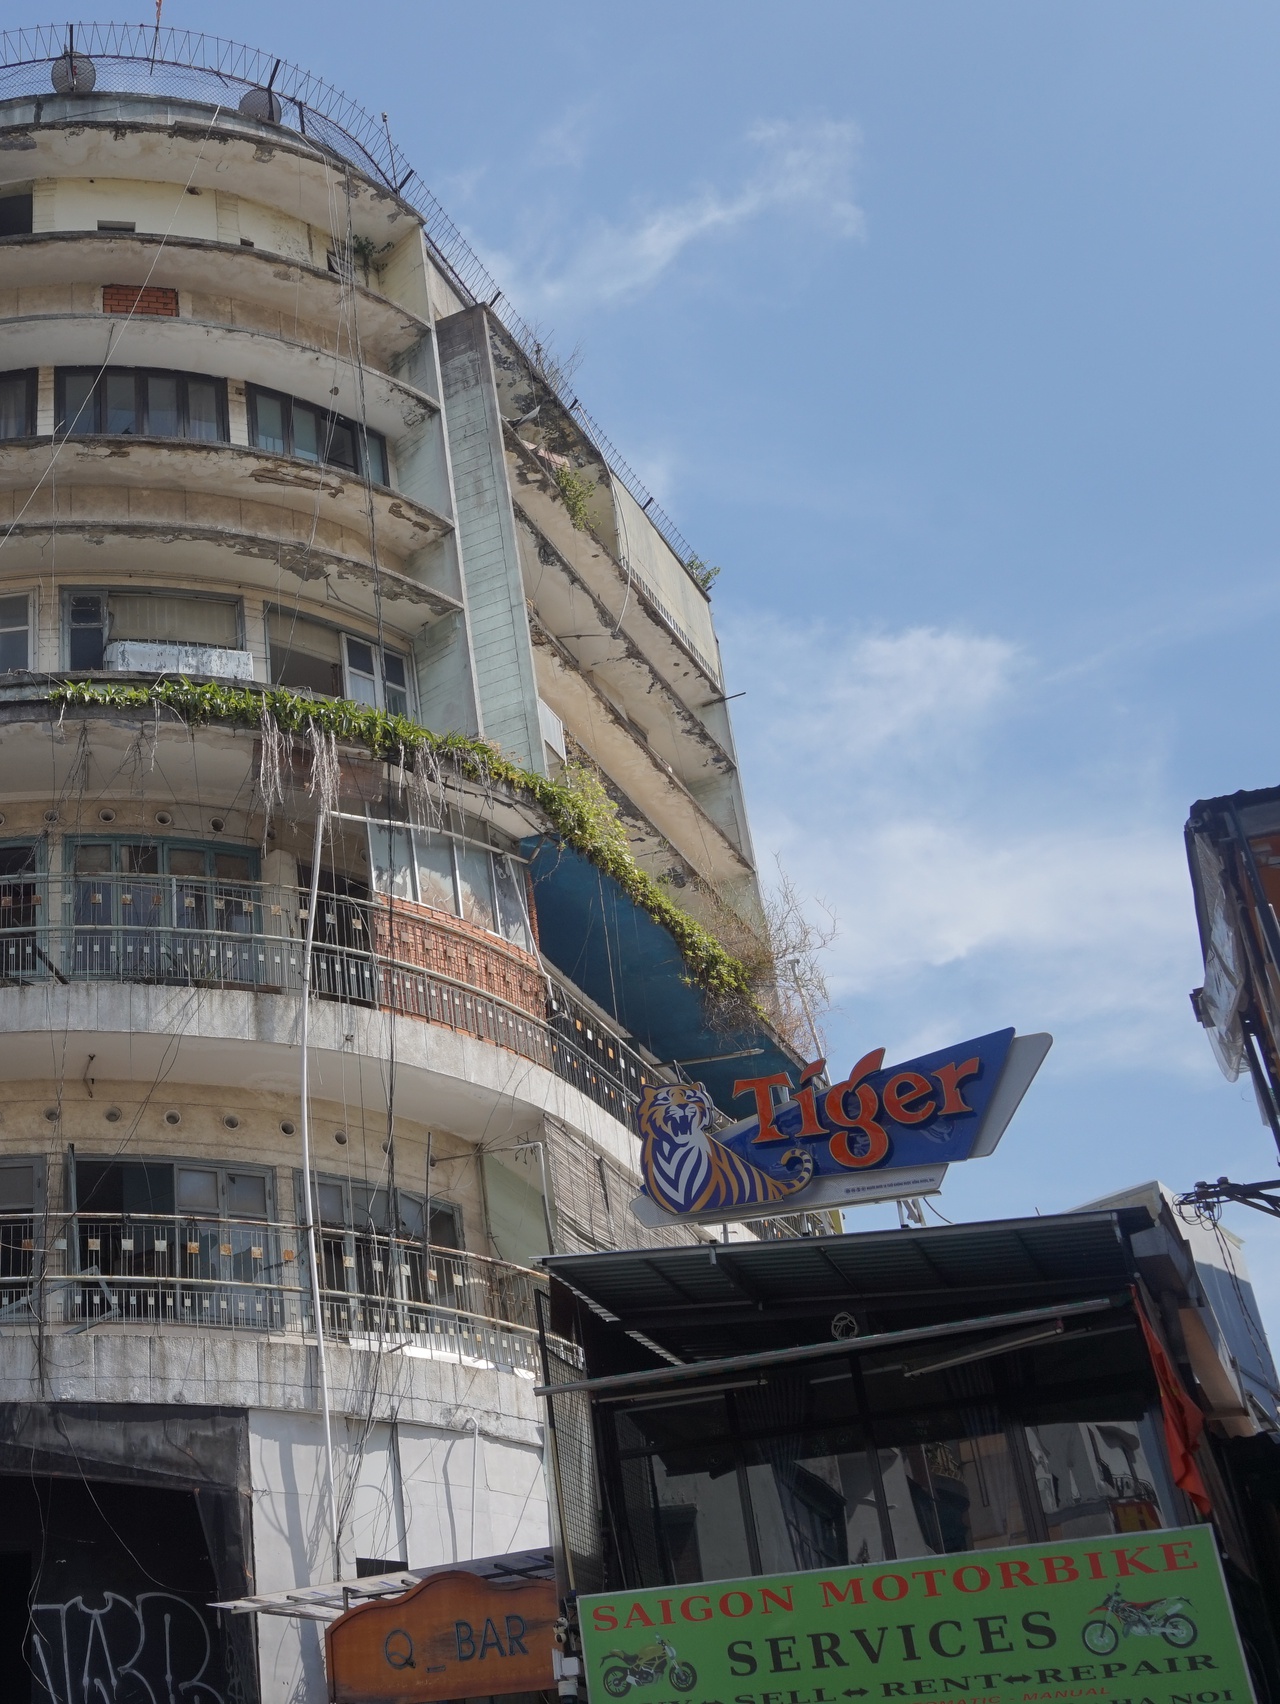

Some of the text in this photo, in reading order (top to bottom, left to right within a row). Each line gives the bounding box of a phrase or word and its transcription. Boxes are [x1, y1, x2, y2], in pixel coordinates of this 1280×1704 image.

[732, 1047, 979, 1168] Tiger
[592, 1541, 1198, 1631] SAIGON MOTORBIKE
[727, 1611, 1057, 1676] SERVICES
[734, 1654, 1219, 1704] SELL RENT REPAIR
[1023, 1687, 1110, 1701] MANUAL
[1168, 1690, 1235, 1704] NOI
